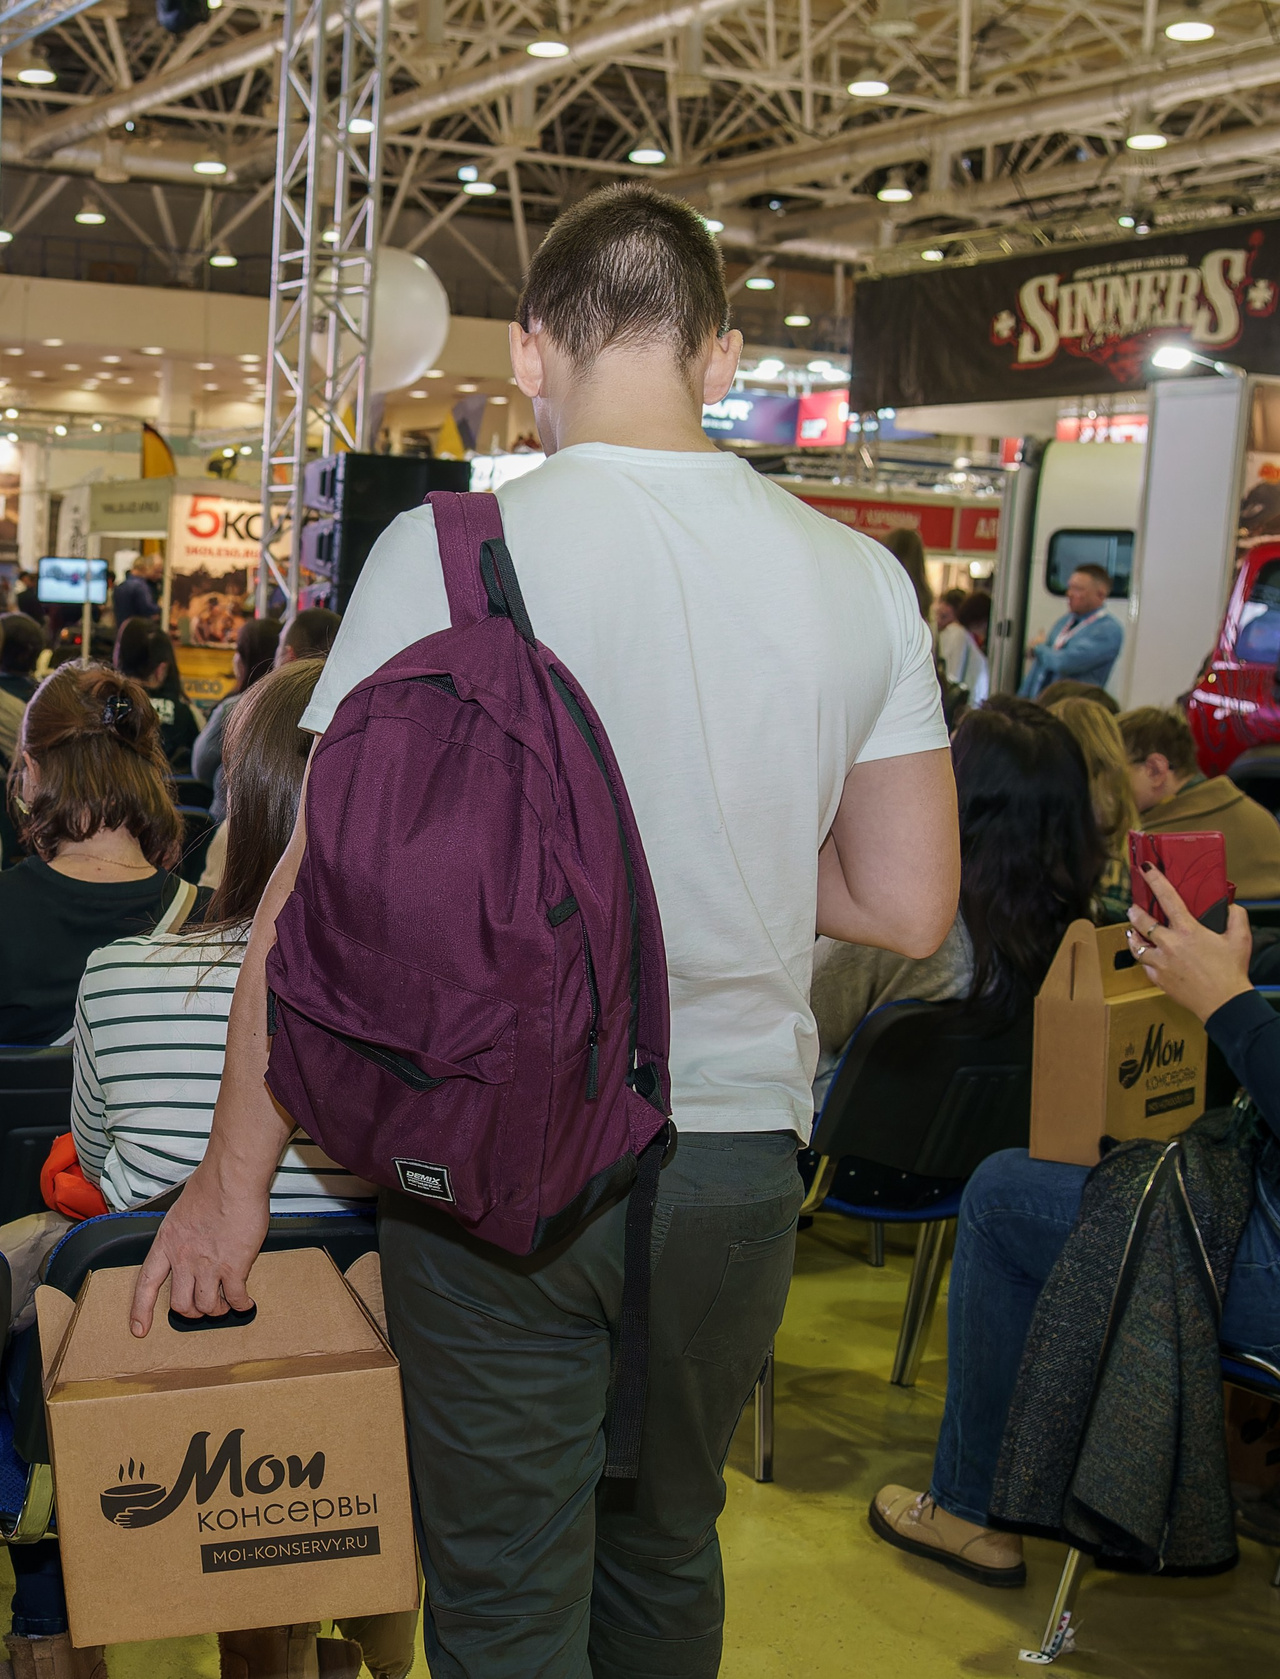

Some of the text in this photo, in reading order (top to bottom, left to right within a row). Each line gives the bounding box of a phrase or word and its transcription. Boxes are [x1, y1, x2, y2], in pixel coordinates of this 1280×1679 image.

[1018, 249, 1248, 363] SINNERS
[405, 1169, 441, 1186] DEMIX
[172, 1428, 326, 1506] Мои
[196, 1493, 378, 1533] консервы
[213, 1535, 369, 1564] MOI-KONSERVY.RU
